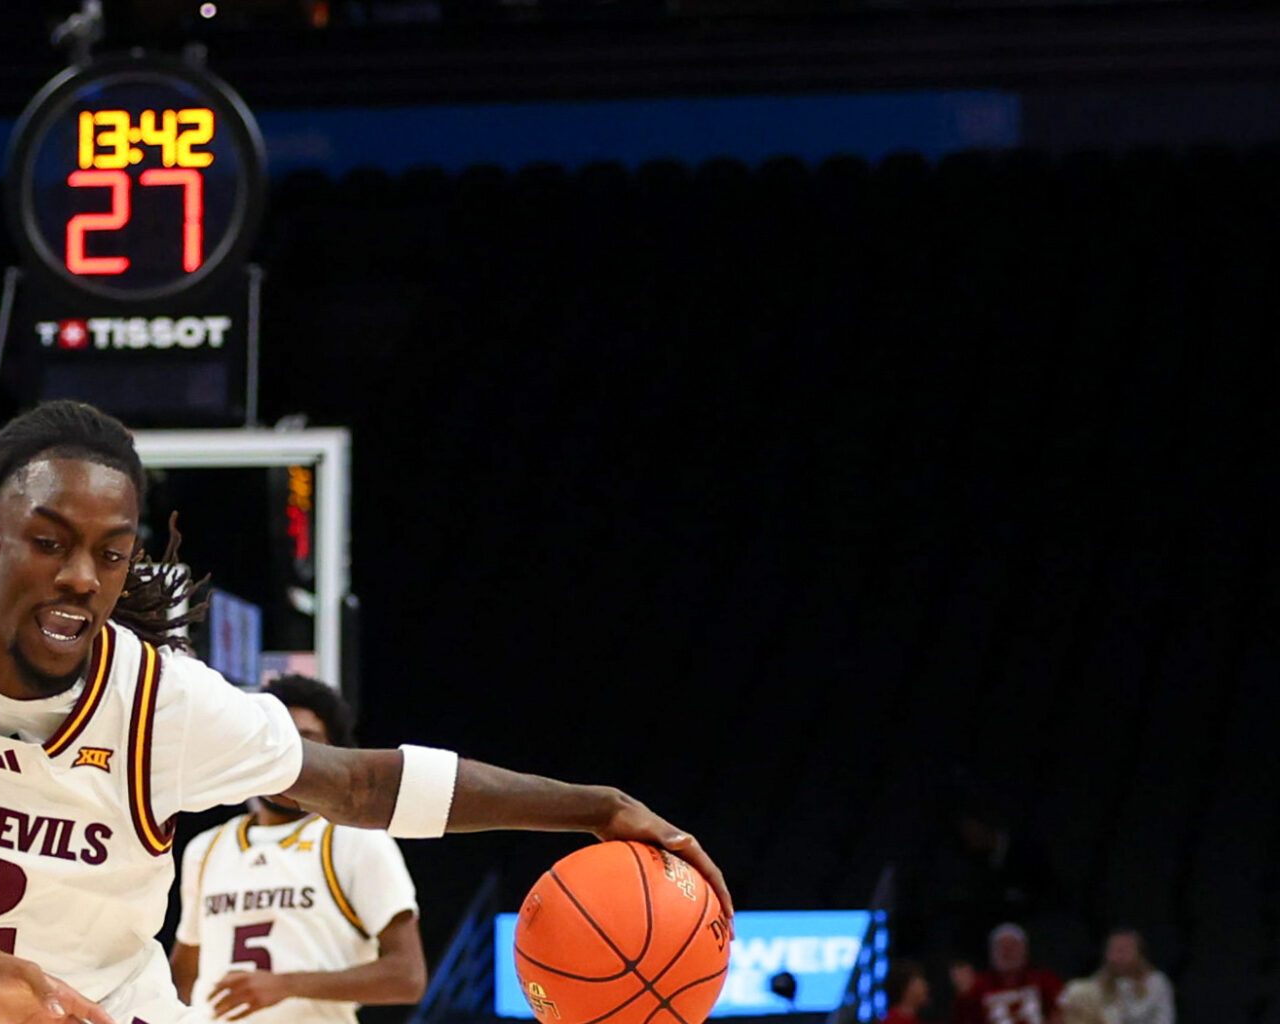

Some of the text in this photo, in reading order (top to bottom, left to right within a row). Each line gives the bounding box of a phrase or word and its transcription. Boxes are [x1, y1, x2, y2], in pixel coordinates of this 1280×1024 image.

[78, 108, 215, 170] 13:42
[66, 168, 205, 275] 27
[88, 316, 232, 349] TISSOT
[242, 886, 316, 911] DEVILS
[231, 920, 275, 973] 5
